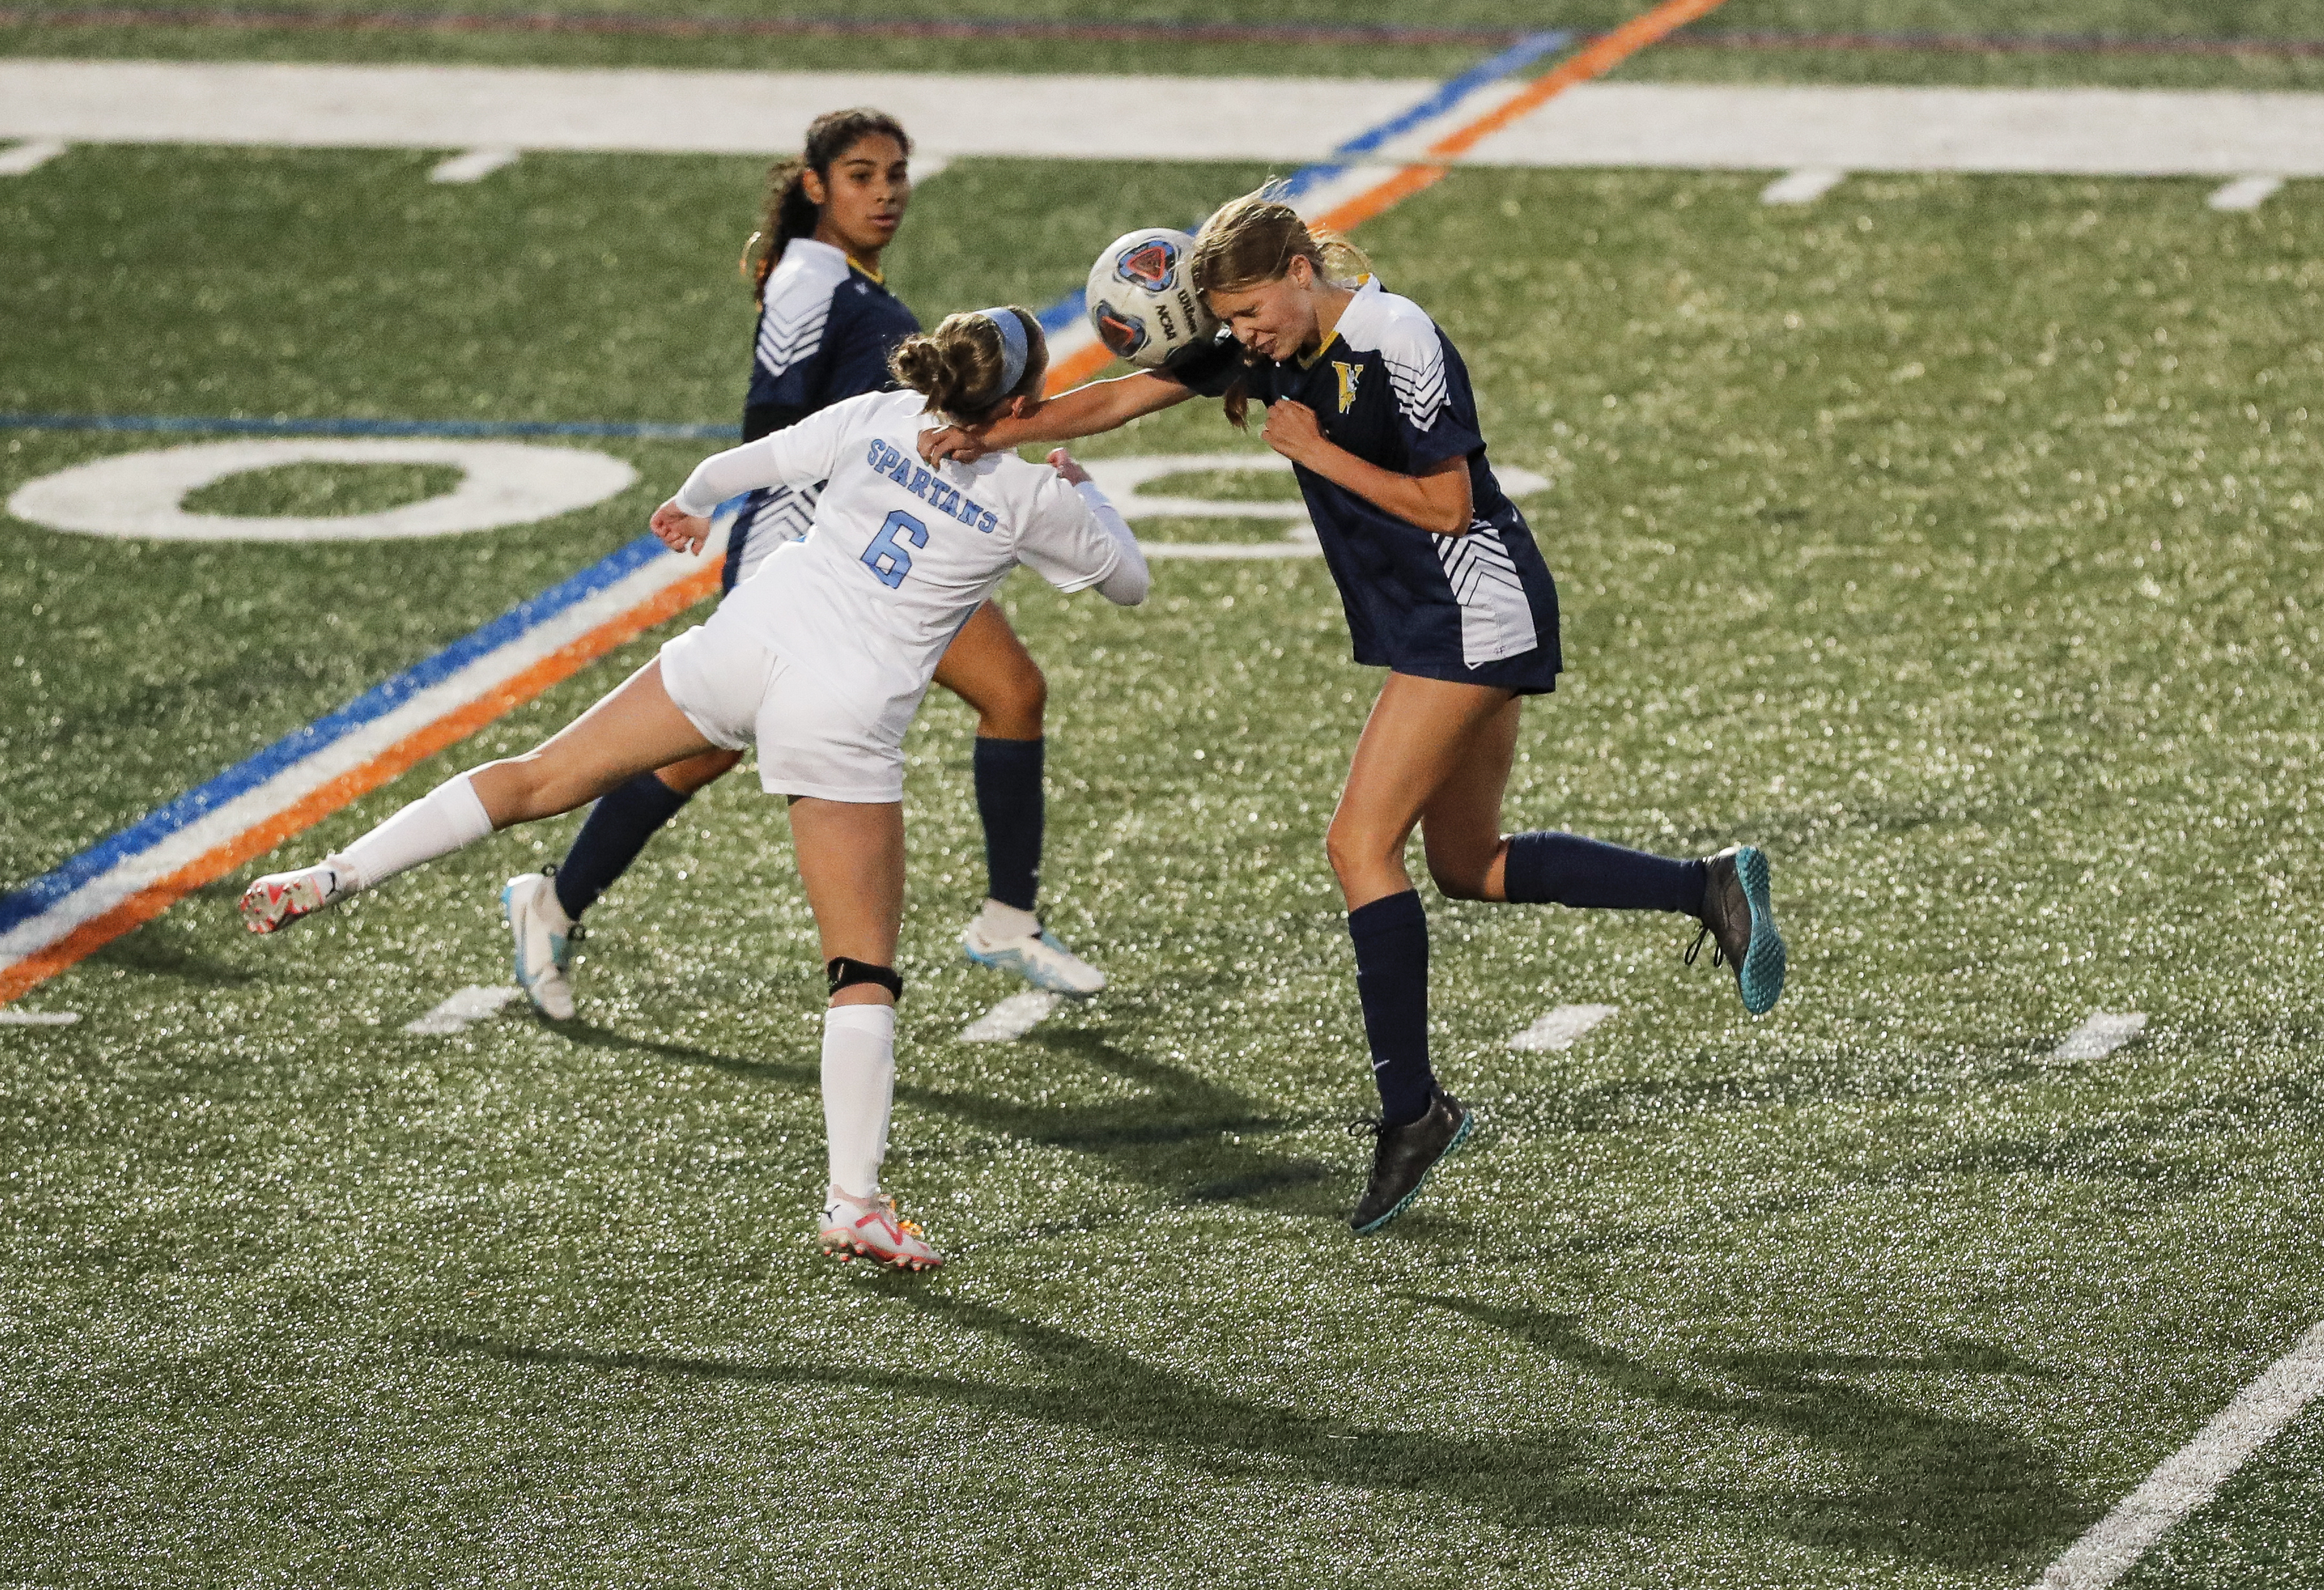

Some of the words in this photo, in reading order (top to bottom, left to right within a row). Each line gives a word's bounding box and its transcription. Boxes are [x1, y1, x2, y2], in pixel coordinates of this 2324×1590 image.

[1156, 303, 1176, 341] NCAA
[867, 439, 999, 534] SPARTANS
[860, 510, 929, 589] 6
